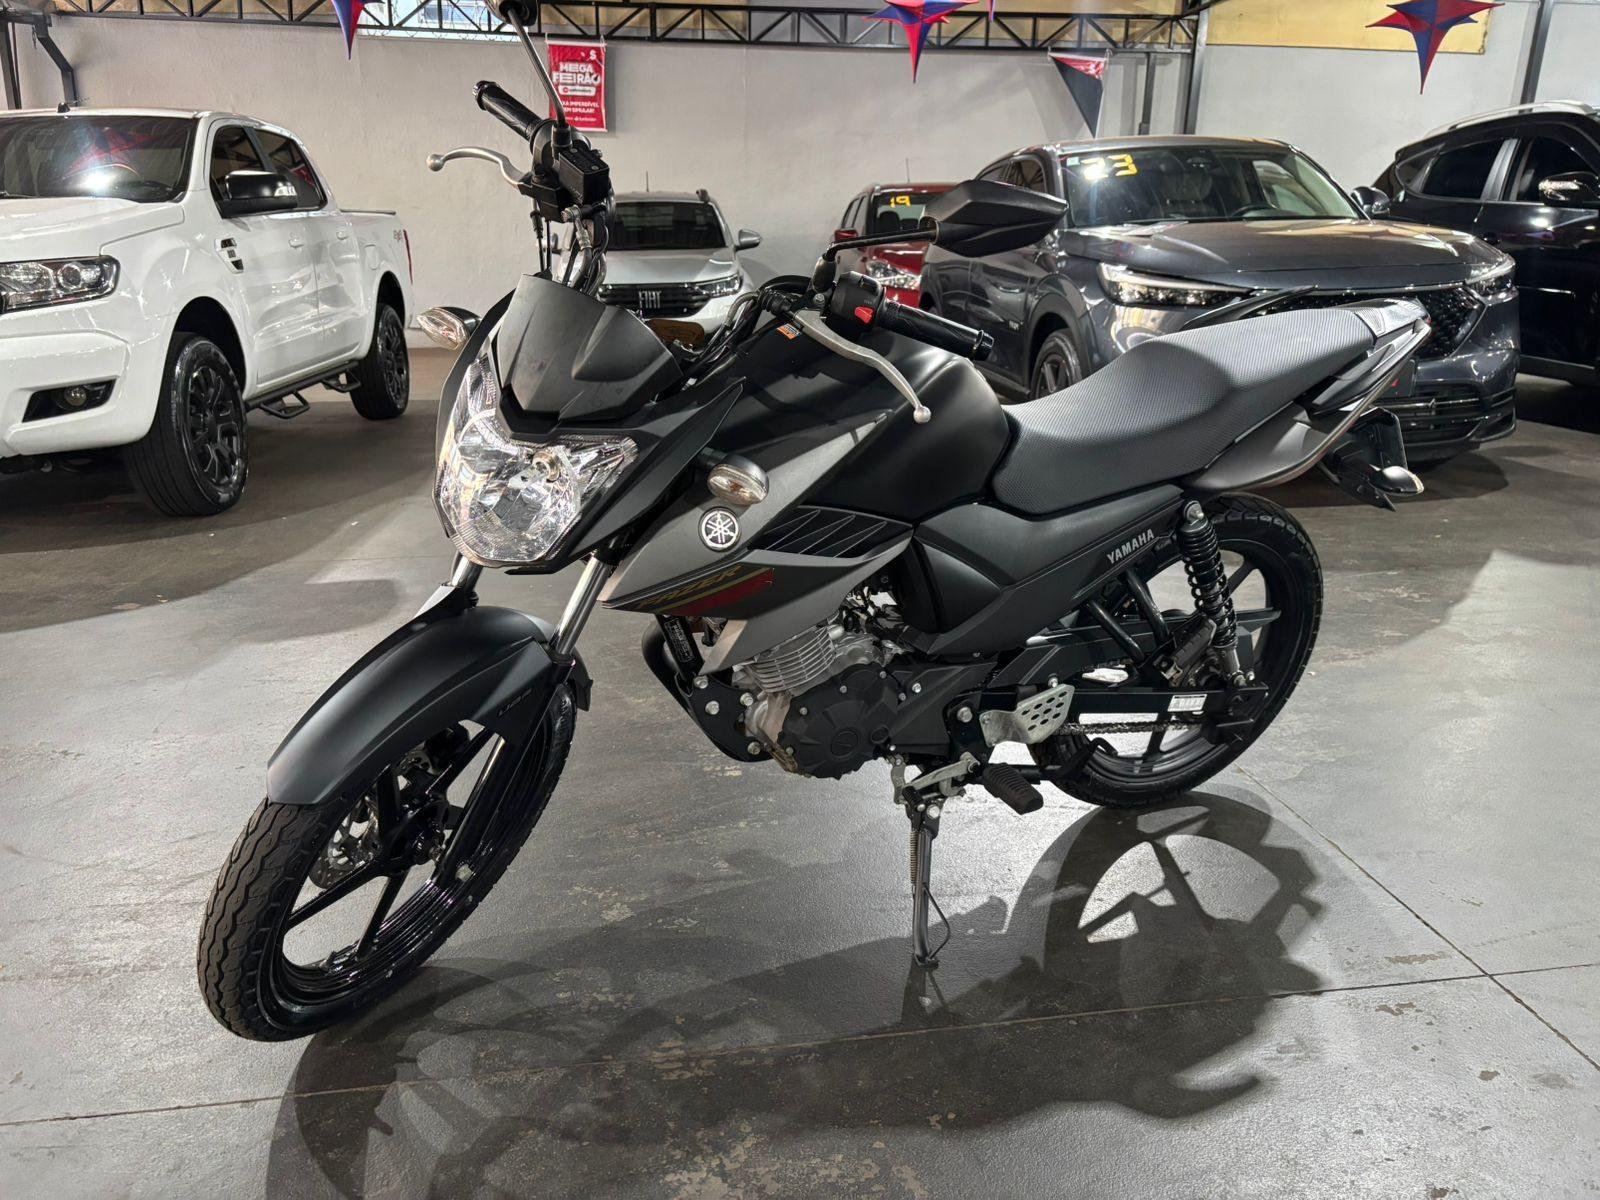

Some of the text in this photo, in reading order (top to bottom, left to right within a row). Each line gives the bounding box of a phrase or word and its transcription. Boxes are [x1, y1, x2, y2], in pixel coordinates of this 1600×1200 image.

[559, 61, 594, 73] MEGA
[552, 71, 602, 86] FEIRÃO
[890, 195, 911, 208] 19
[638, 290, 662, 309] FIAT
[1107, 528, 1154, 564] YAMAHA
